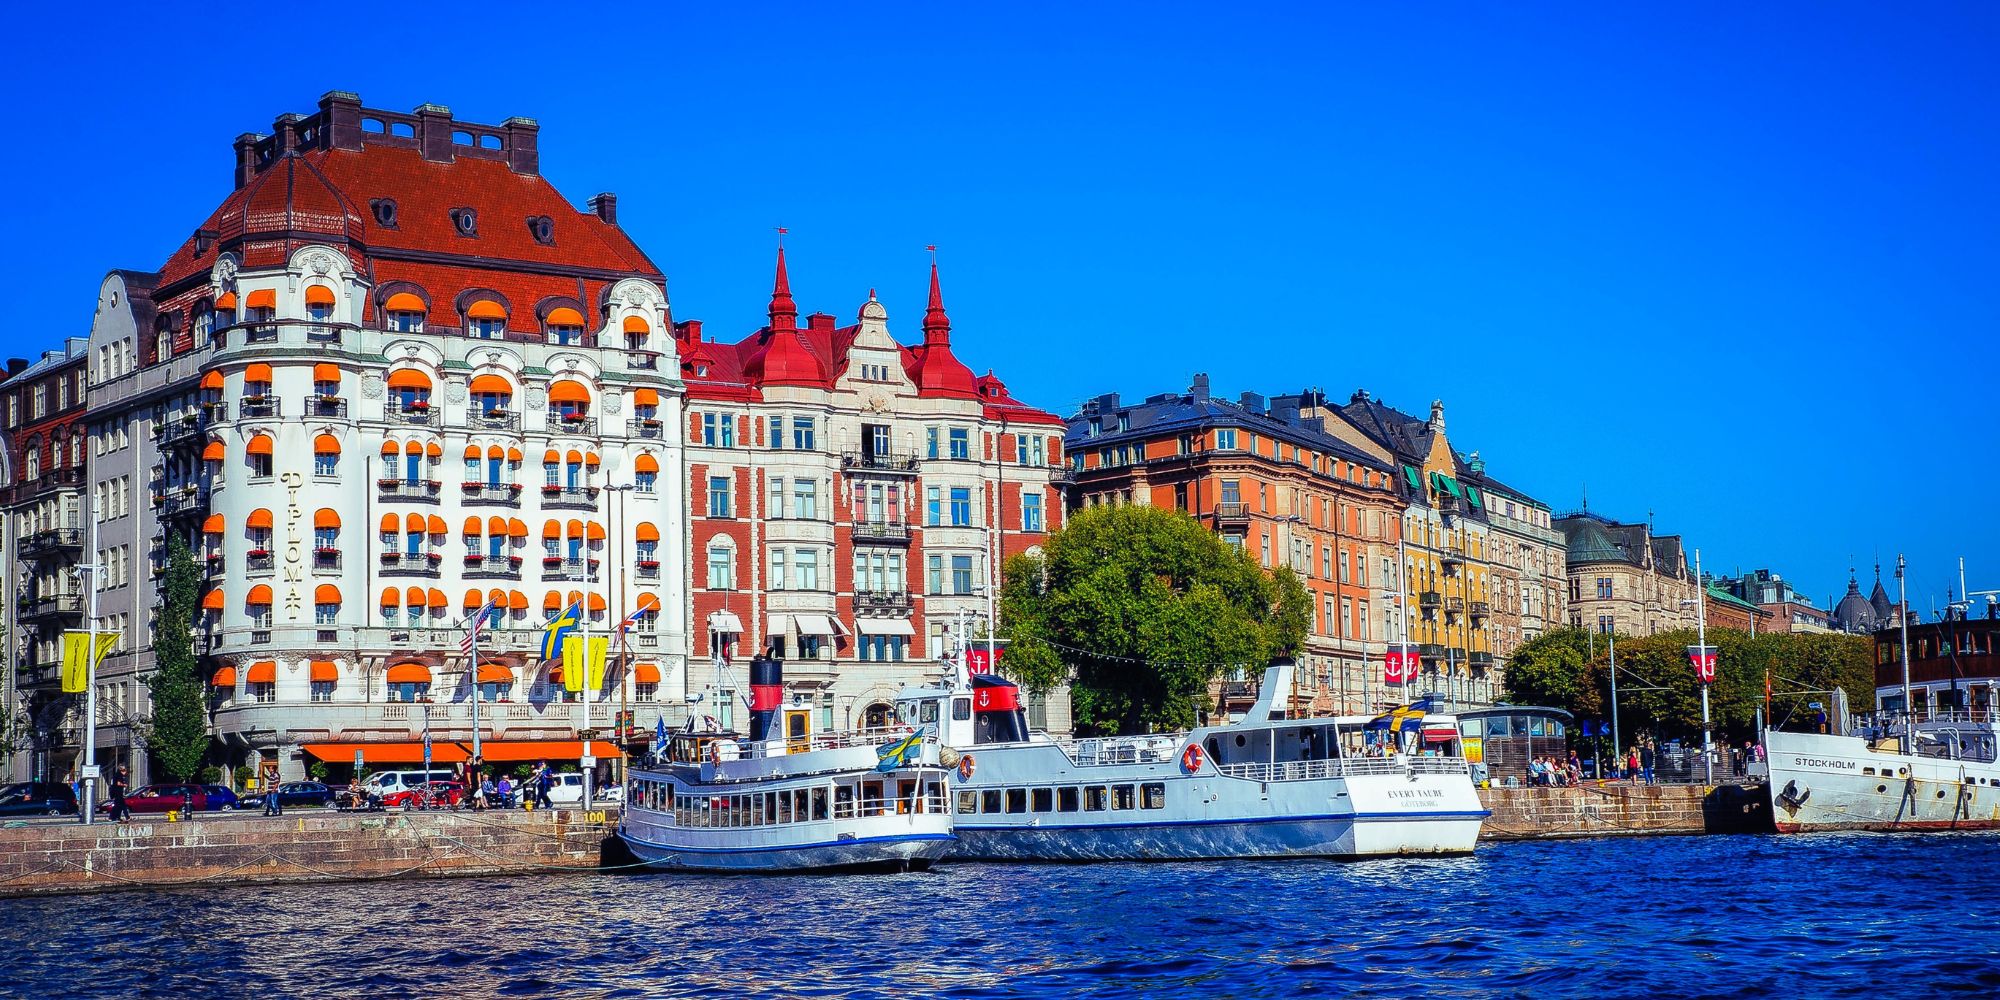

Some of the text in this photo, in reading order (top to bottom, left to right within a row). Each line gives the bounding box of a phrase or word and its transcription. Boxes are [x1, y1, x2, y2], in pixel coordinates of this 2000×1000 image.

[280, 472, 303, 620] DIPLOMAT
[1795, 757, 1856, 769] STOCKHOLM
[1387, 789, 1444, 798] EVERT TAUBE
